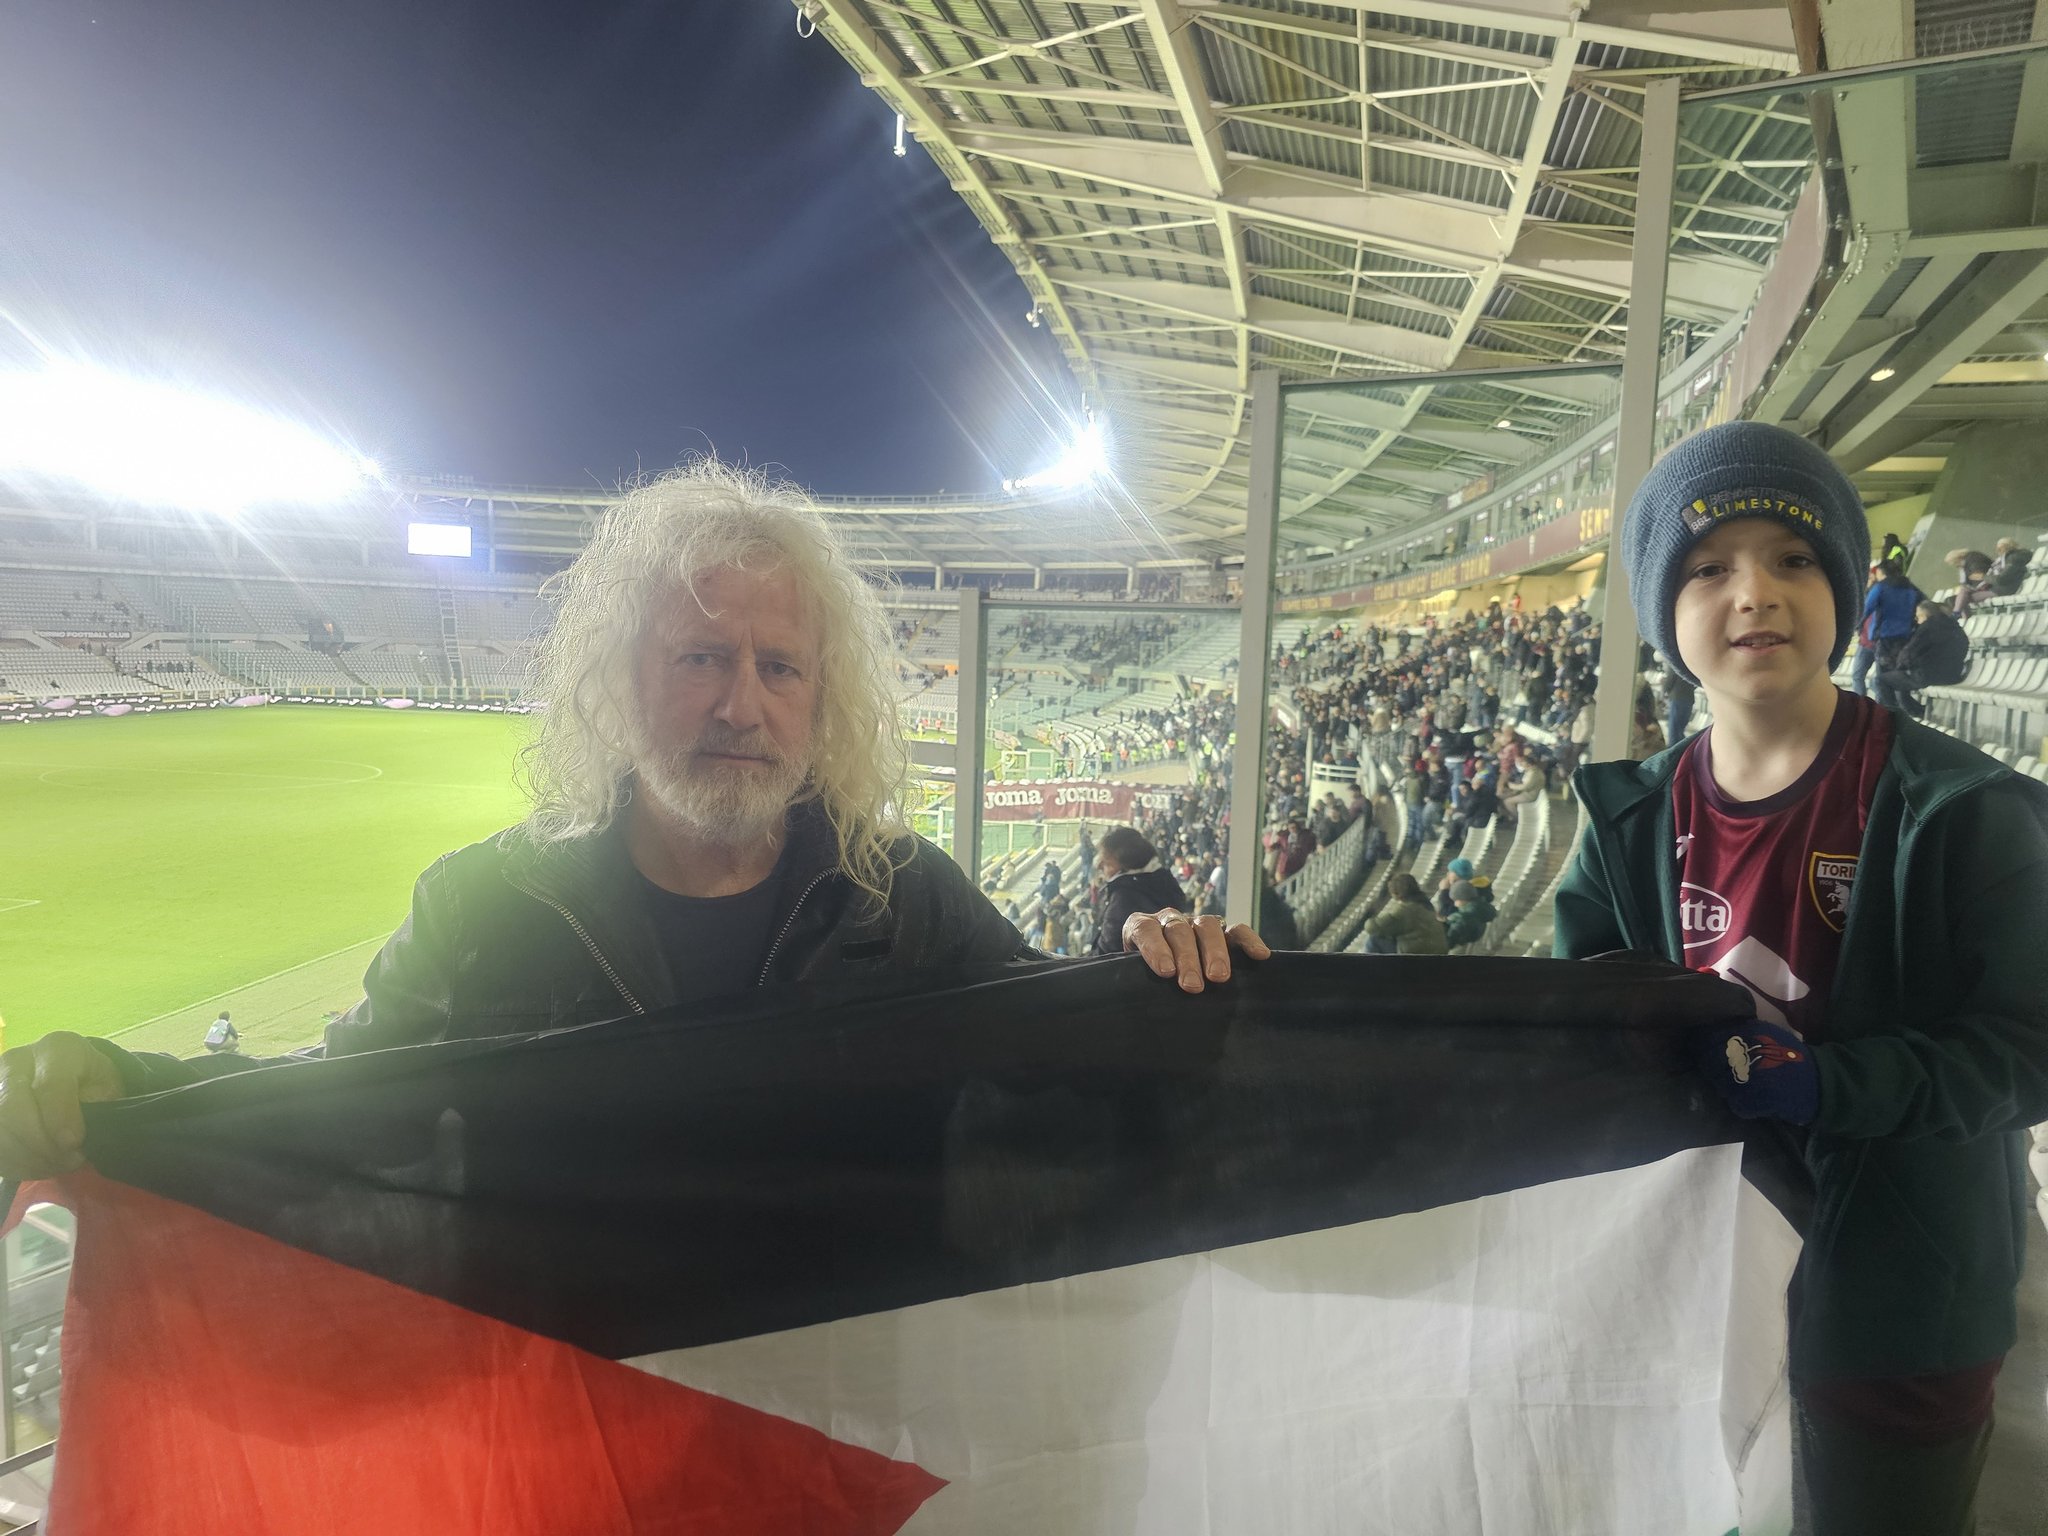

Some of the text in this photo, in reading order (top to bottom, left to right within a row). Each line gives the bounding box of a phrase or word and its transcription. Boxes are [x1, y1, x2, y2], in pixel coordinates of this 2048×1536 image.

[1691, 515, 1711, 531] BBL
[1713, 498, 1823, 529] LIMESTONE
[1680, 898, 1727, 932] tta
